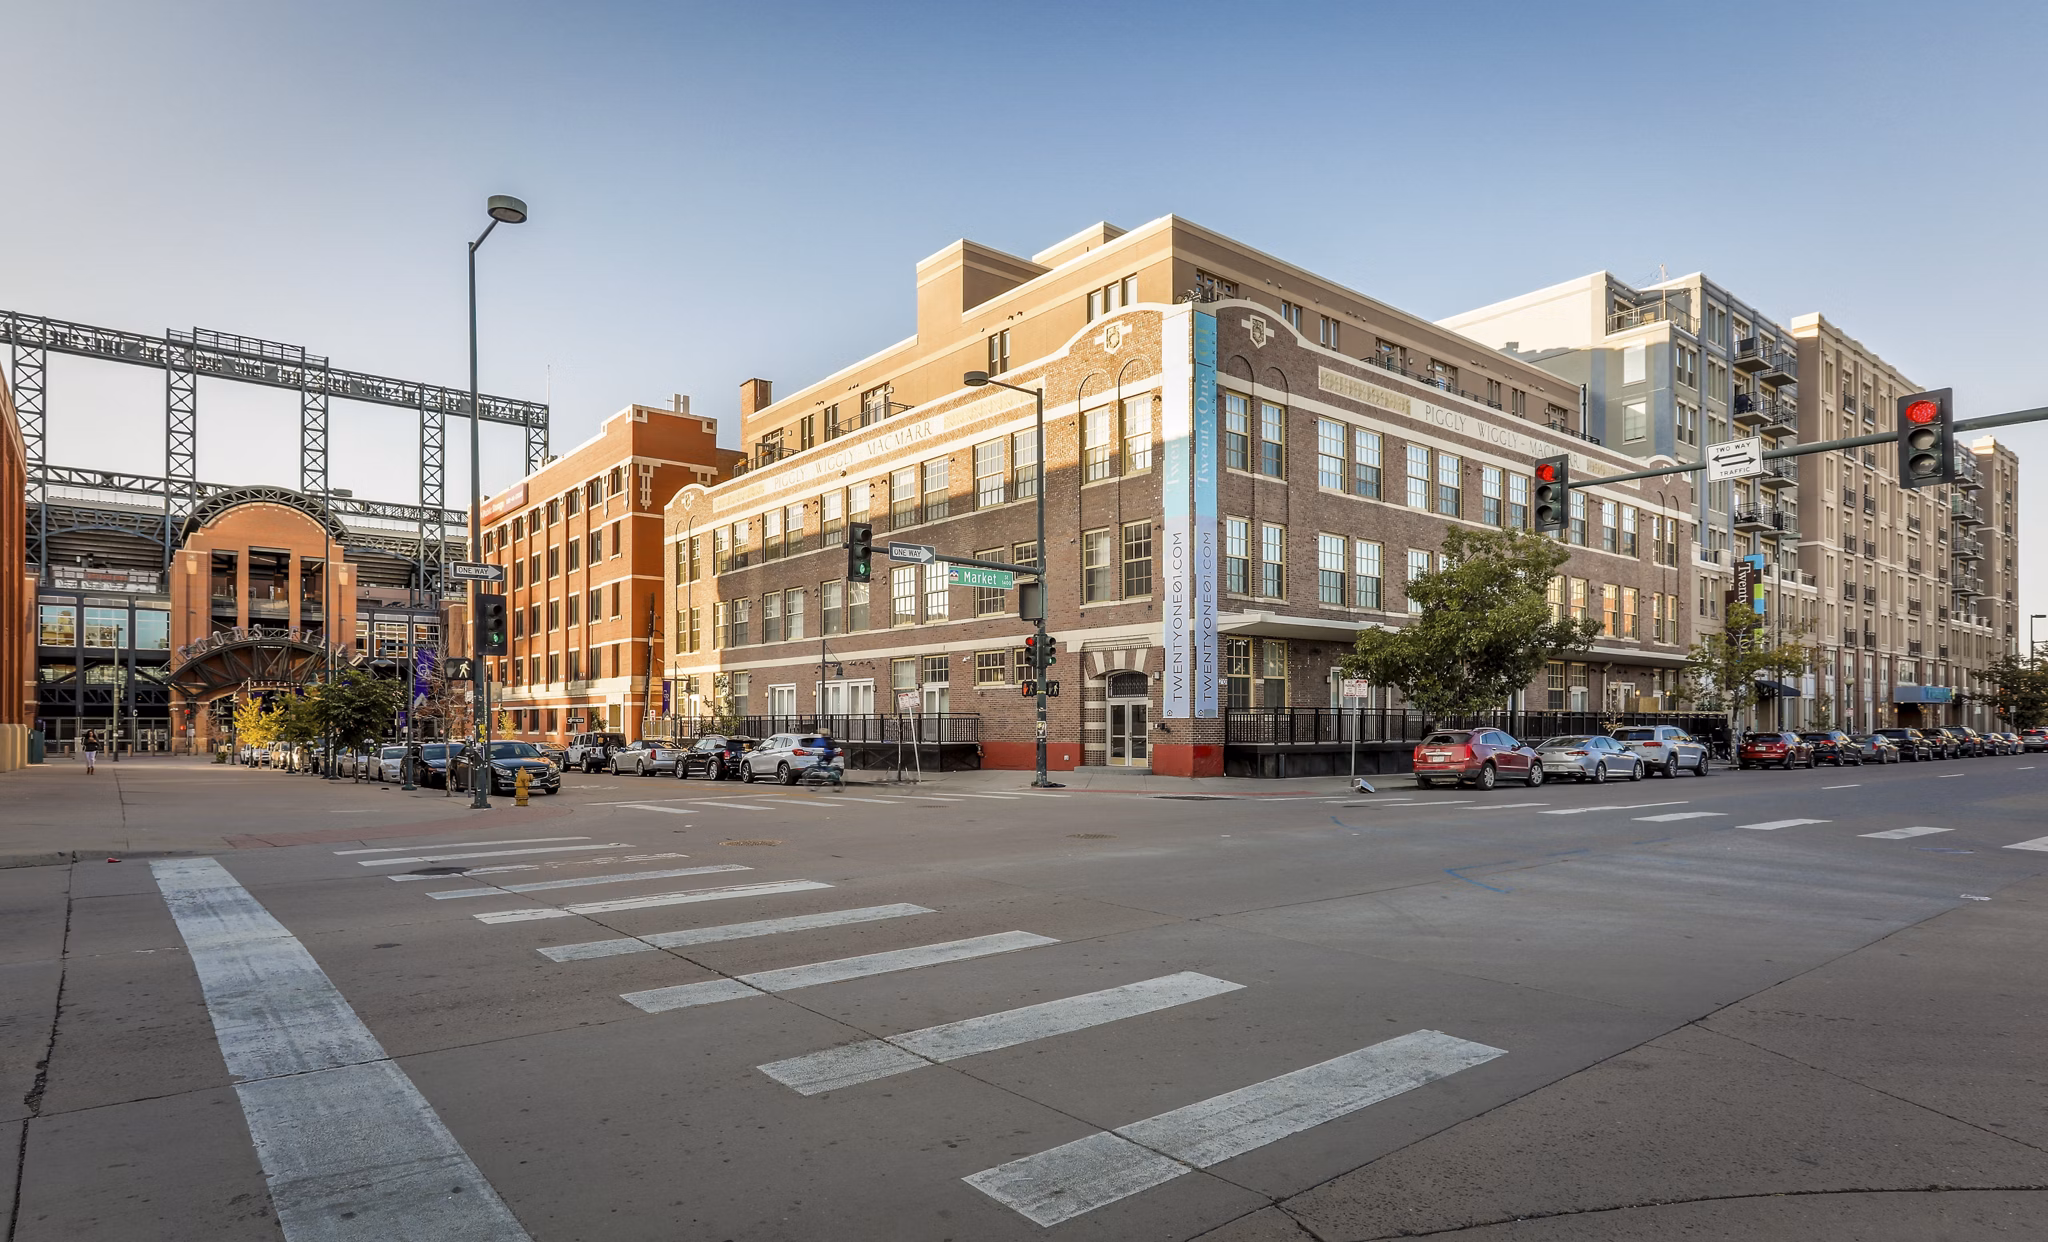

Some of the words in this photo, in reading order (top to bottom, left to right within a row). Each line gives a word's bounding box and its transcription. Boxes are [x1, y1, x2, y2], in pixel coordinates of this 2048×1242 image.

[1425, 404, 1467, 432] PIGGLY
[1477, 422, 1520, 449] WIGGLY
[1716, 445, 1731, 453] TWO
[1735, 442, 1751, 450] WAY
[773, 468, 806, 490] PIGGLY
[815, 451, 856, 475] WIGGLY
[866, 421, 933, 455] MACMARR
[1720, 466, 1751, 477] TRAFFIC
[893, 548, 907, 557] ONE
[908, 549, 921, 558] WAY
[457, 566, 473, 574] ONE
[963, 571, 997, 585] Market
[177, 623, 263, 661] COORS
